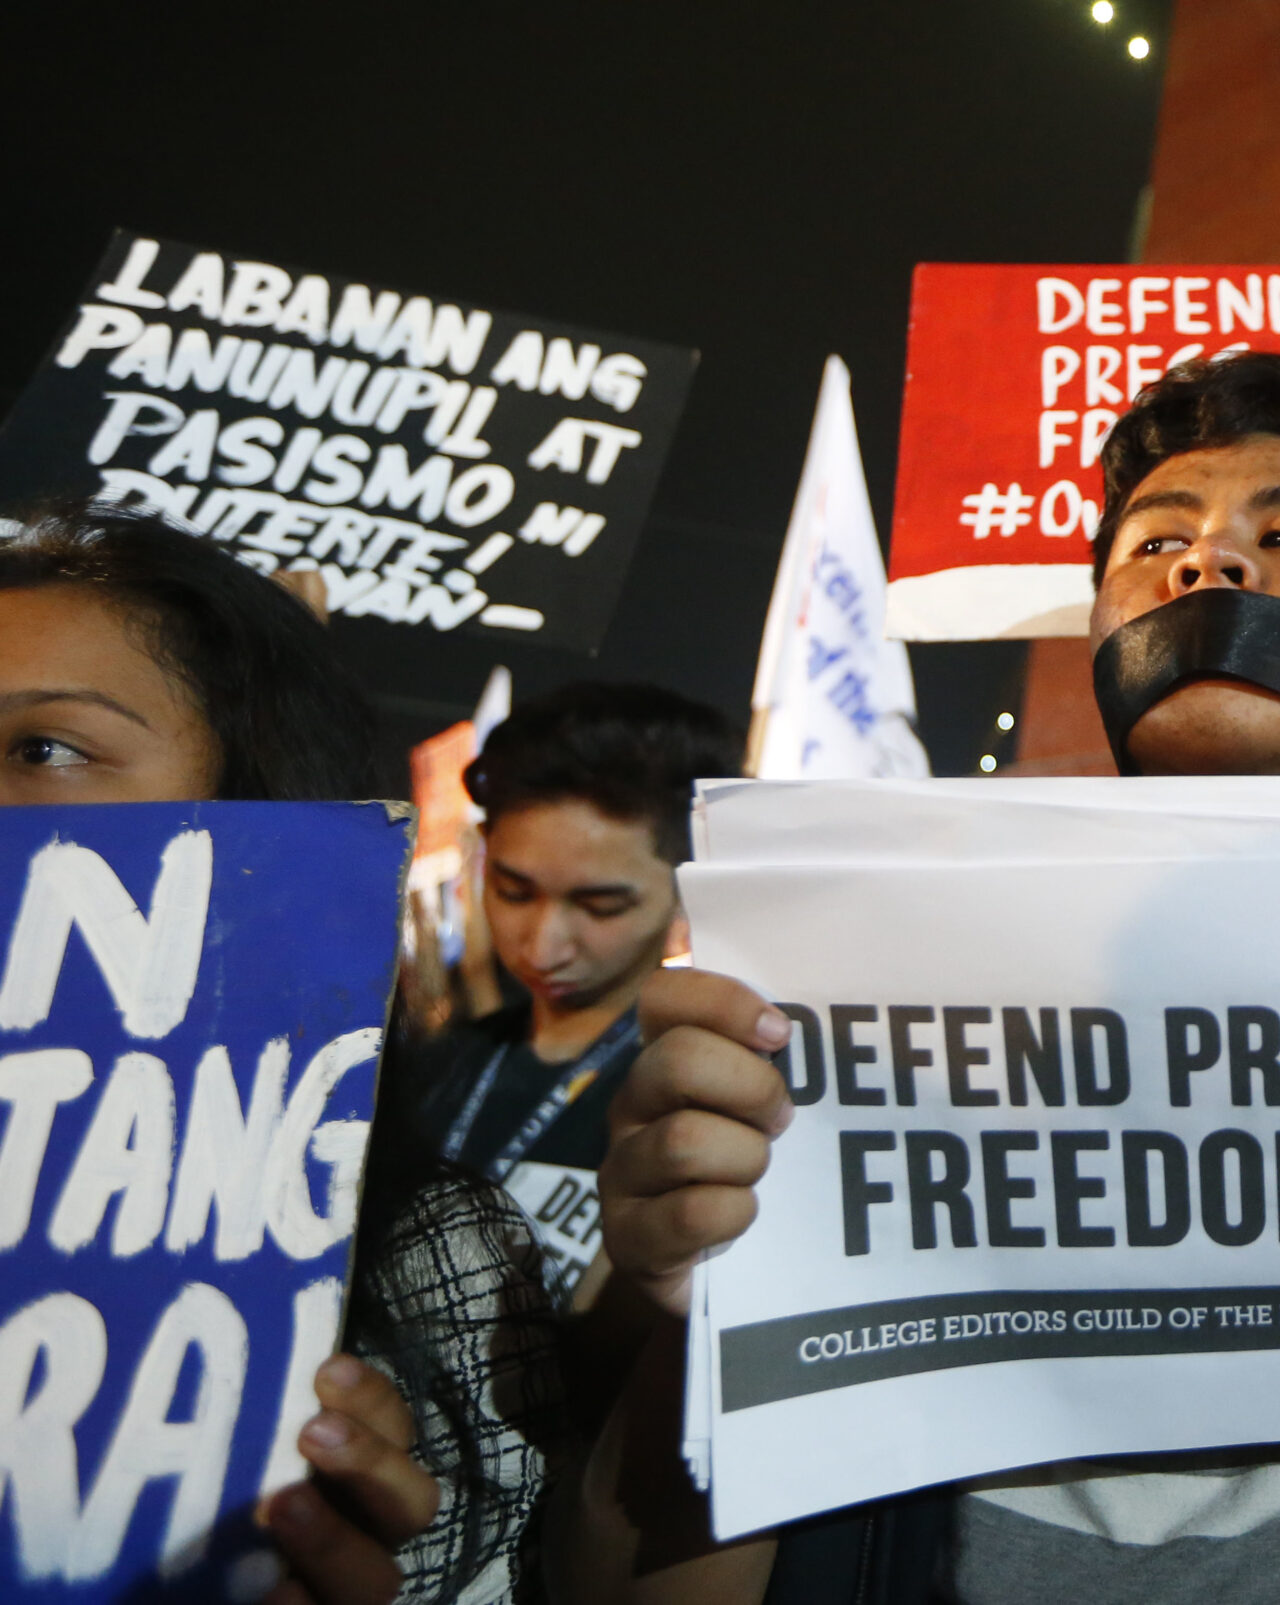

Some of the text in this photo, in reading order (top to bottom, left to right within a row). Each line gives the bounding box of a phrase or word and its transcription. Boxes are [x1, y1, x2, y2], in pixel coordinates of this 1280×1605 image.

[96, 238, 648, 413] LABANAN ANG
[1041, 342, 1251, 408] PRE
[55, 304, 642, 485] PANUNUPIL AT
[87, 390, 606, 557] PASISMO NI
[773, 1001, 1132, 1107] DEFEND
[799, 1317, 937, 1364] COLLEGE
[943, 1308, 1067, 1340] EDITORS
[1072, 1308, 1163, 1333] GUILD
[1168, 1306, 1208, 1329] OF
[1213, 1304, 1273, 1327] THE
